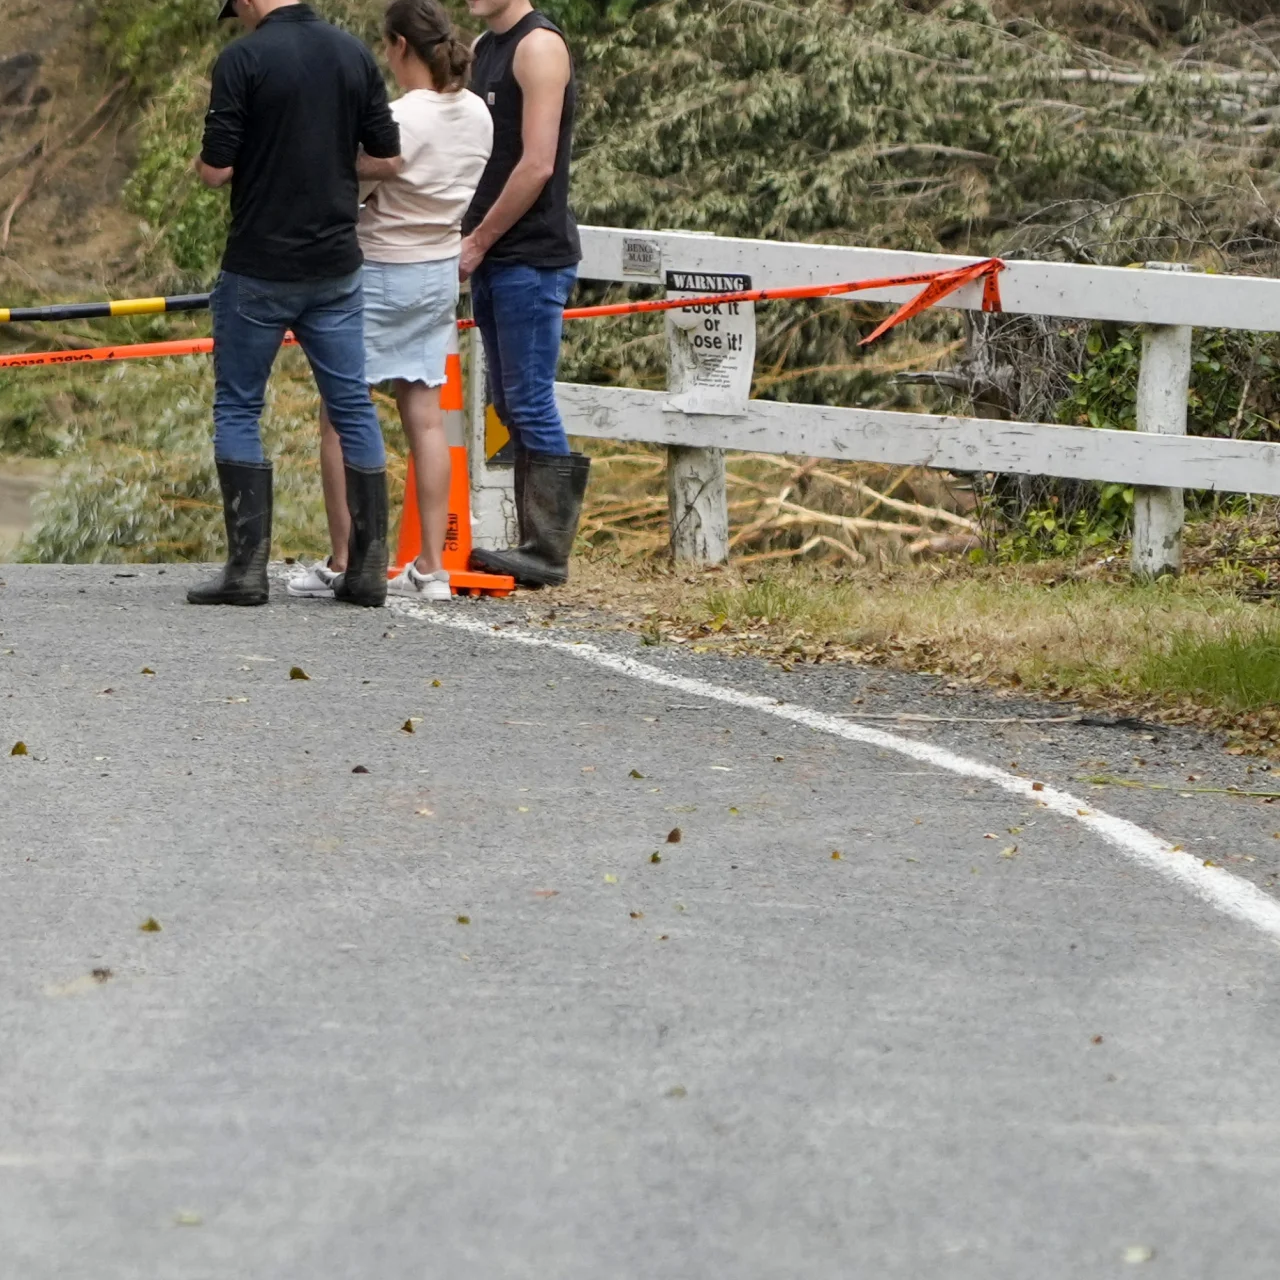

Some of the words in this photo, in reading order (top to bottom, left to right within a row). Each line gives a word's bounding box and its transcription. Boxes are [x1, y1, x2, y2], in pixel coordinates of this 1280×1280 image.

[672, 273, 744, 292] WARNING
[704, 318, 721, 332] or
[691, 335, 723, 349] ose
[726, 332, 743, 351] it!
